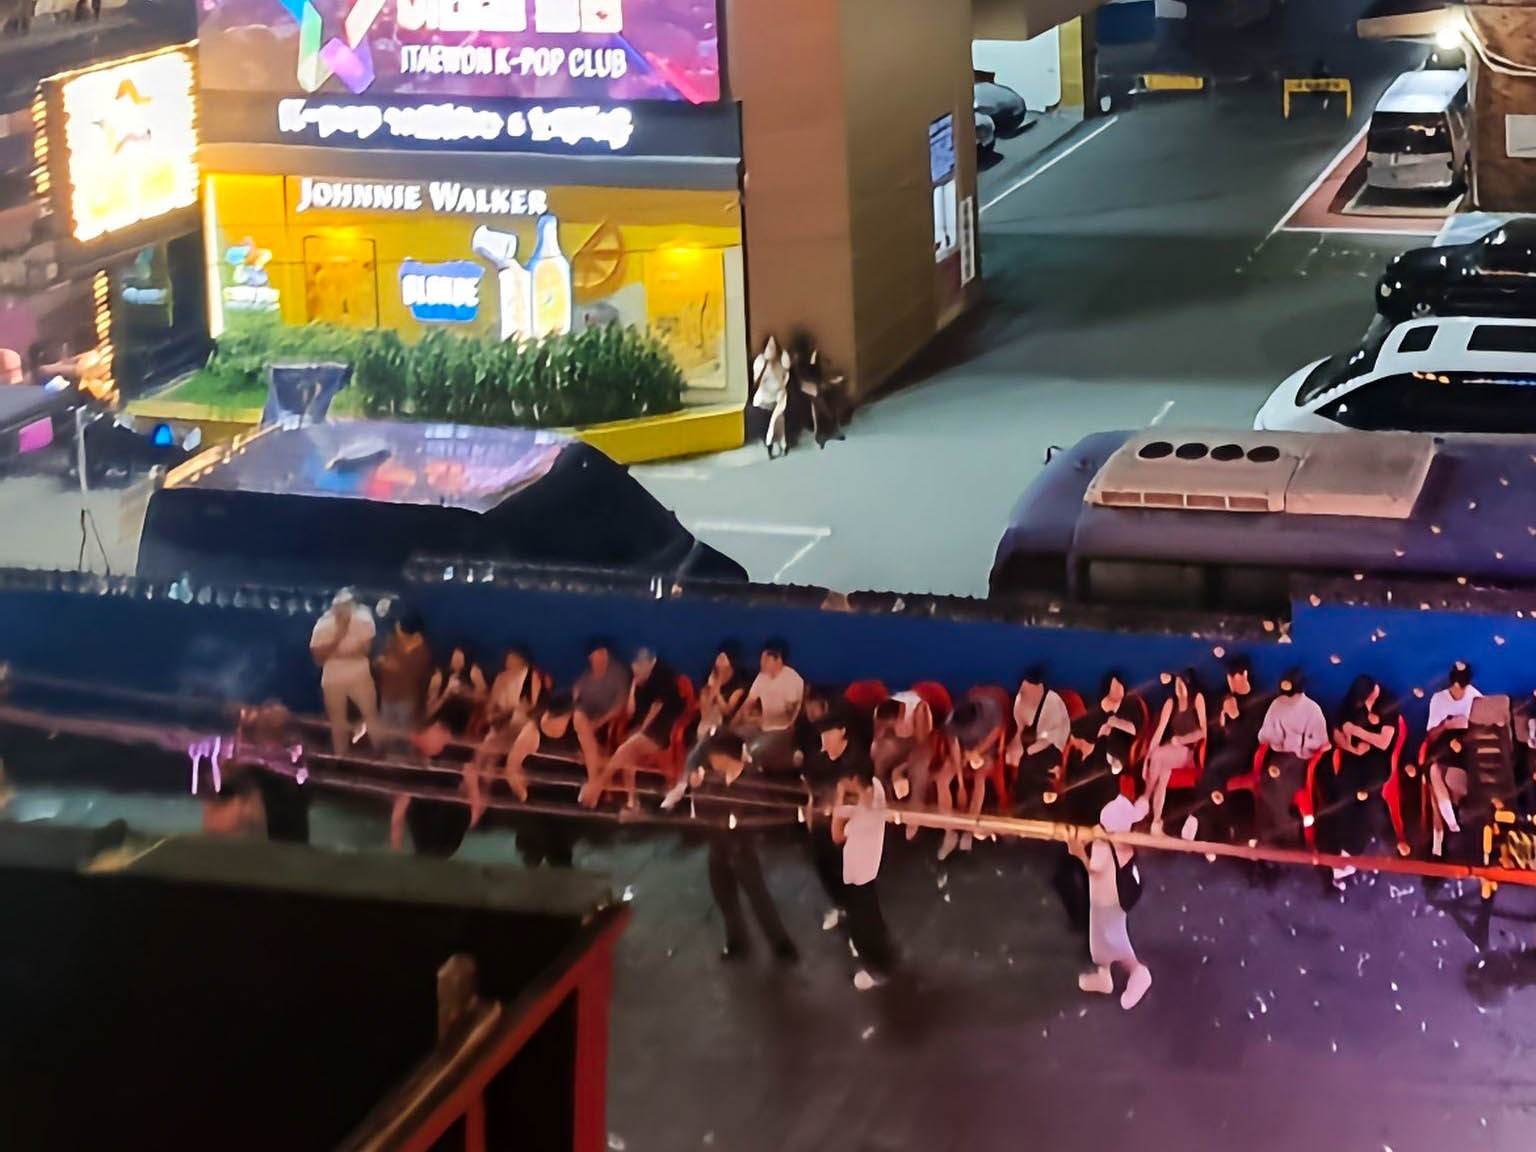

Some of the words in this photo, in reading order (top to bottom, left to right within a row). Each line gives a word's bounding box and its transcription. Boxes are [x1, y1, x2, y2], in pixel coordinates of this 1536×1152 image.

[400, 45, 492, 74] ITAEWON
[494, 46, 566, 76] K-POP
[568, 48, 628, 78] CLUB
[296, 178, 423, 213] JOHNNIE
[428, 181, 549, 215] WALKER
